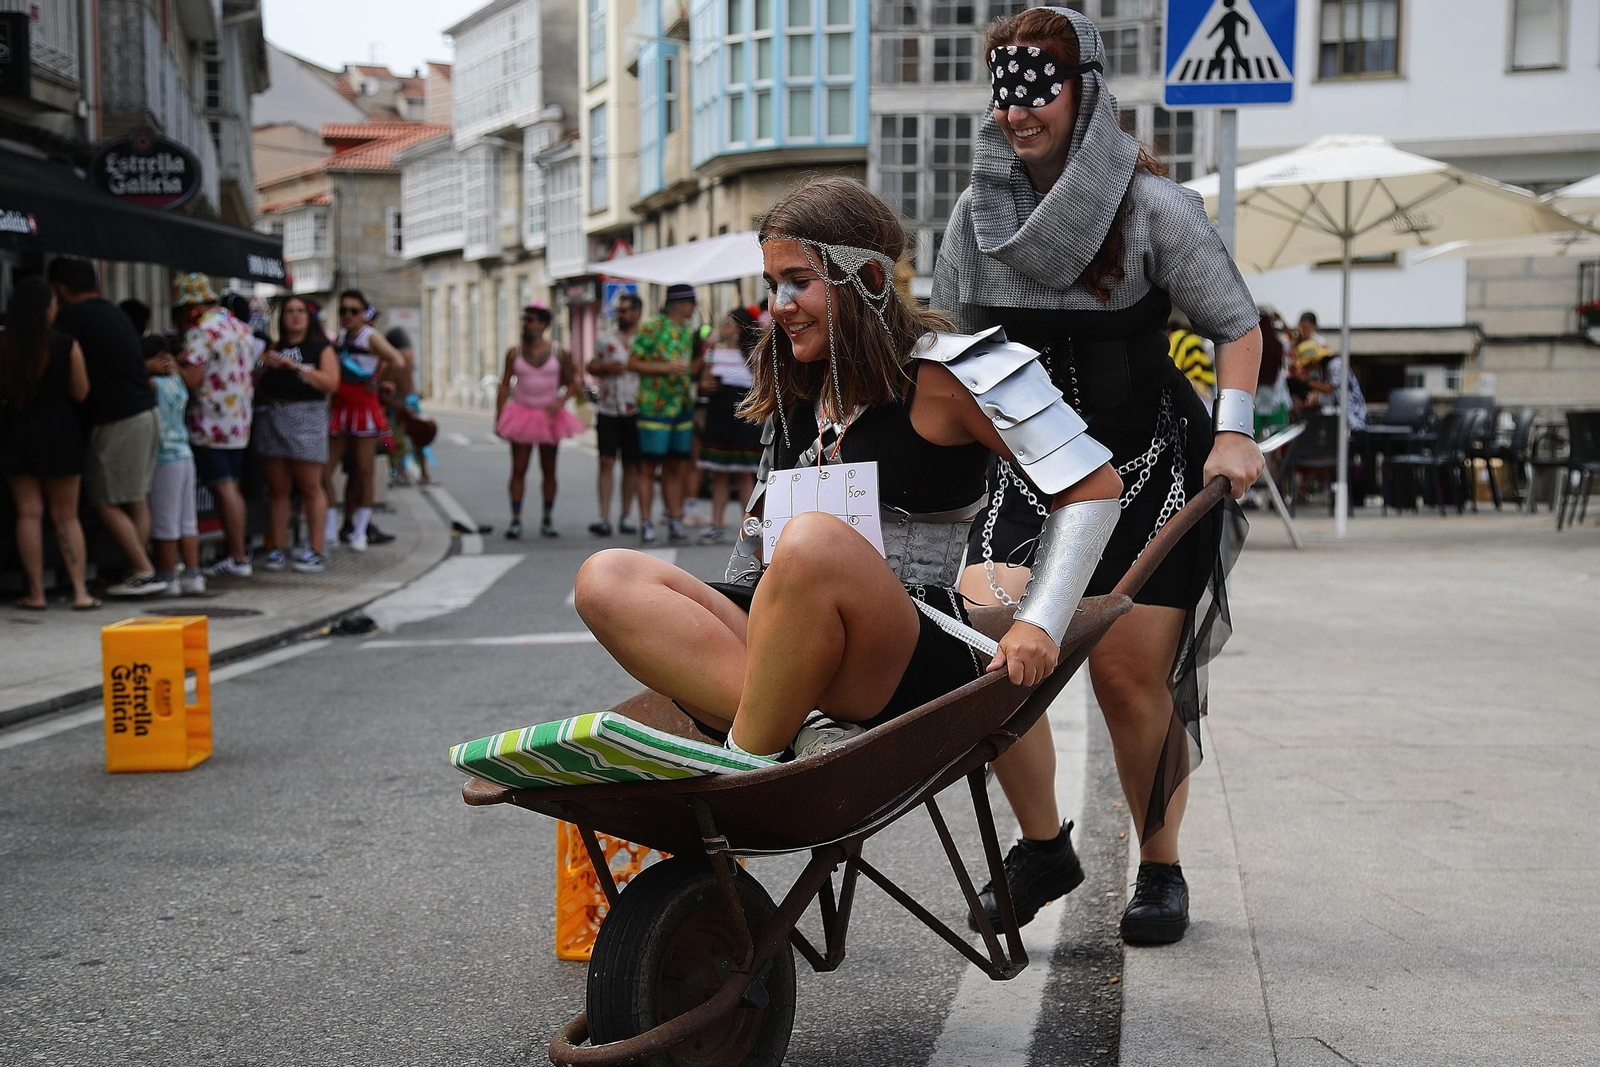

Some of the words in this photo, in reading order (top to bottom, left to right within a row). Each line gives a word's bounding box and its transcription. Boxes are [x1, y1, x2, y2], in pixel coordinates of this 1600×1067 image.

[106, 152, 185, 174] Estrella
[108, 174, 183, 195] Galicia
[849, 485, 866, 498] 500
[111, 665, 132, 734] Galicia
[132, 662, 152, 737] Estrella
